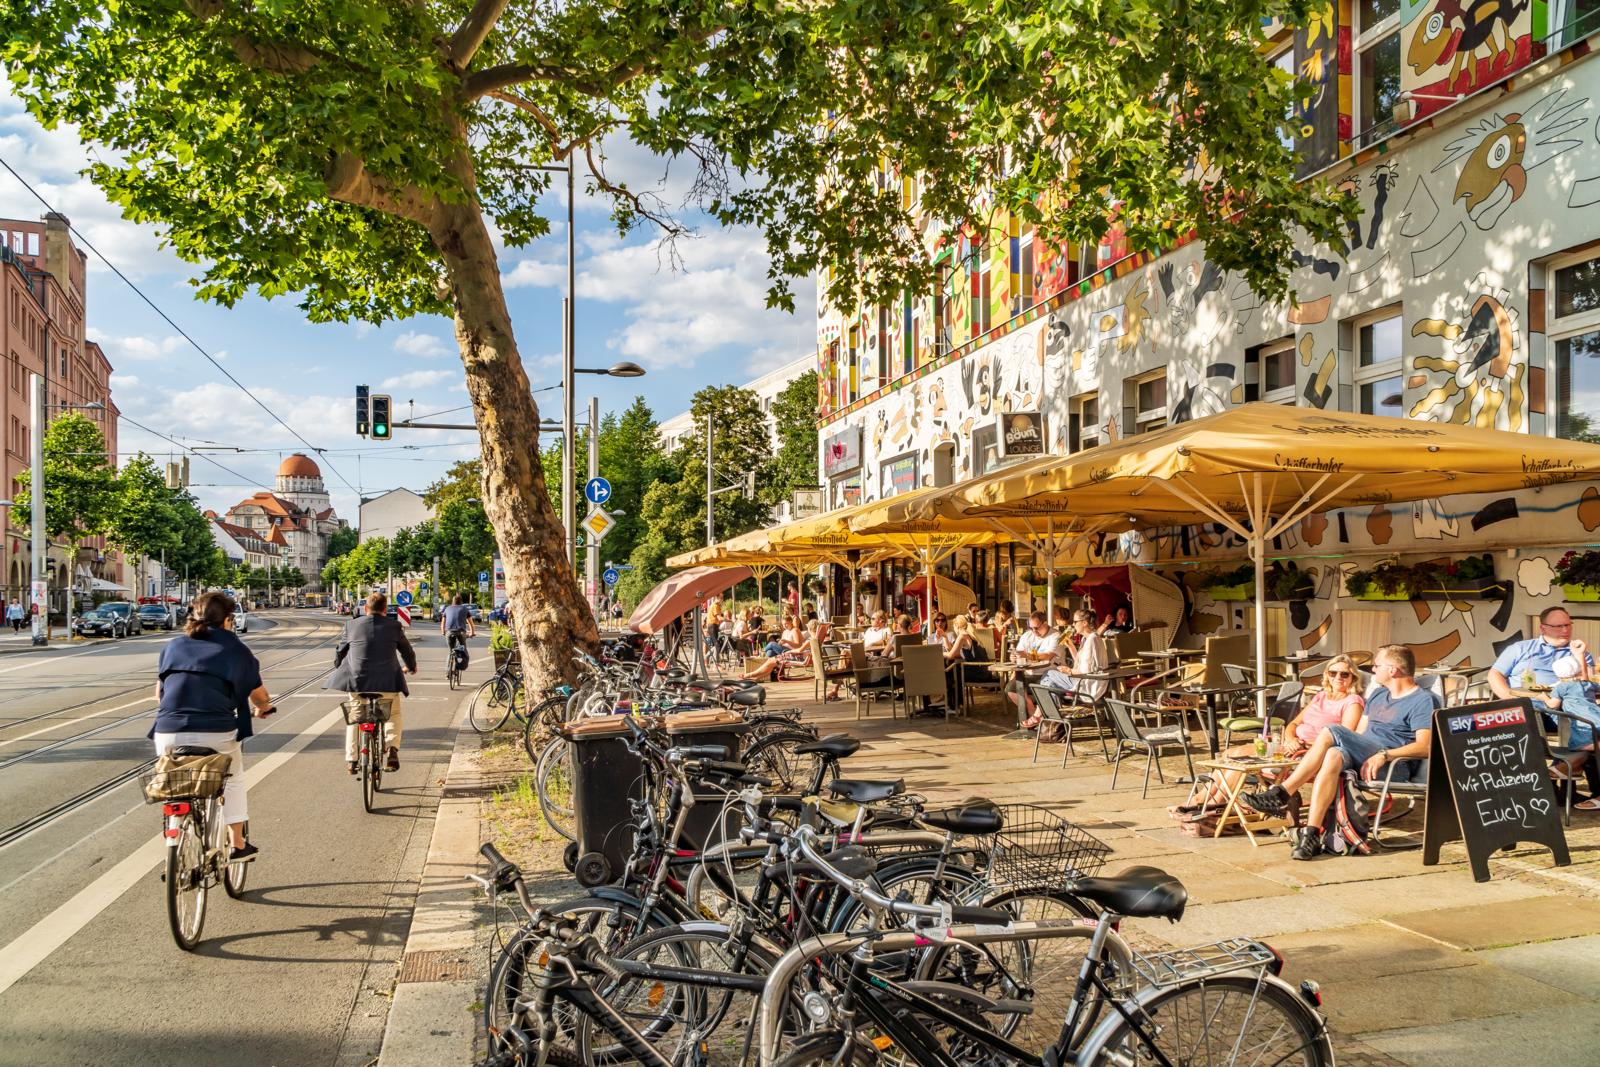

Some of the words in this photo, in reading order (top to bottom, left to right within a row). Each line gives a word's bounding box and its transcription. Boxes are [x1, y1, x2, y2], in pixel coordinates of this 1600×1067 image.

[1009, 444, 1041, 454] LOUNGE
[1451, 717, 1472, 732] sky
[1476, 709, 1521, 728] SPORT
[1467, 738, 1479, 746] Hier
[1480, 736, 1491, 744] live
[1491, 732, 1516, 742] erleben
[1476, 797, 1537, 828] Euch
